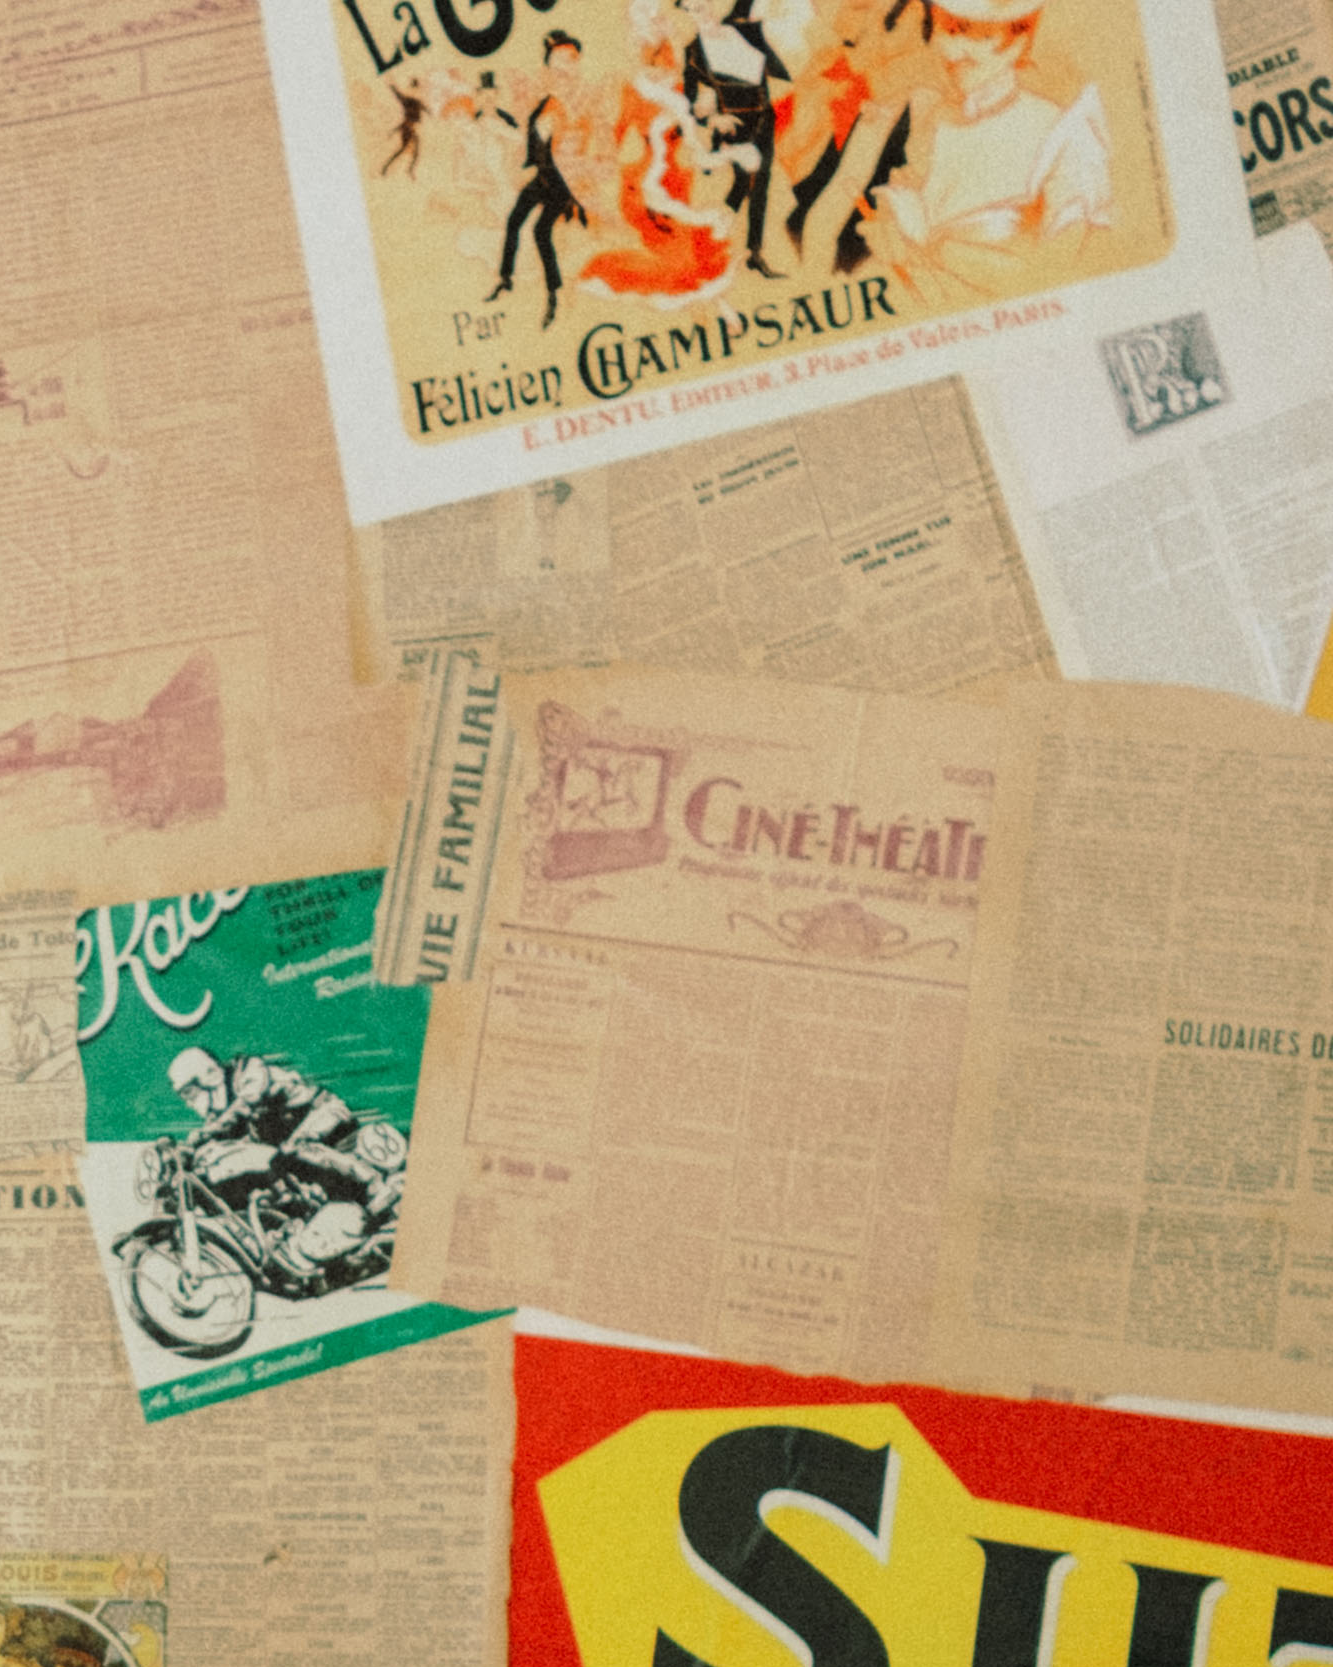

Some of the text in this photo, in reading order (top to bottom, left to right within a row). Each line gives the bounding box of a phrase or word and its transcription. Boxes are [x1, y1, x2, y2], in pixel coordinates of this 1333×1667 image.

[343, 0, 430, 74] La
[1228, 48, 1300, 87] DIABLE
[411, 277, 896, 433] Félicien CHAMPSAUR
[452, 310, 506, 346] Par
[416, 911, 458, 985] VIE
[1164, 1017, 1301, 1058] SOLIDAIRES
